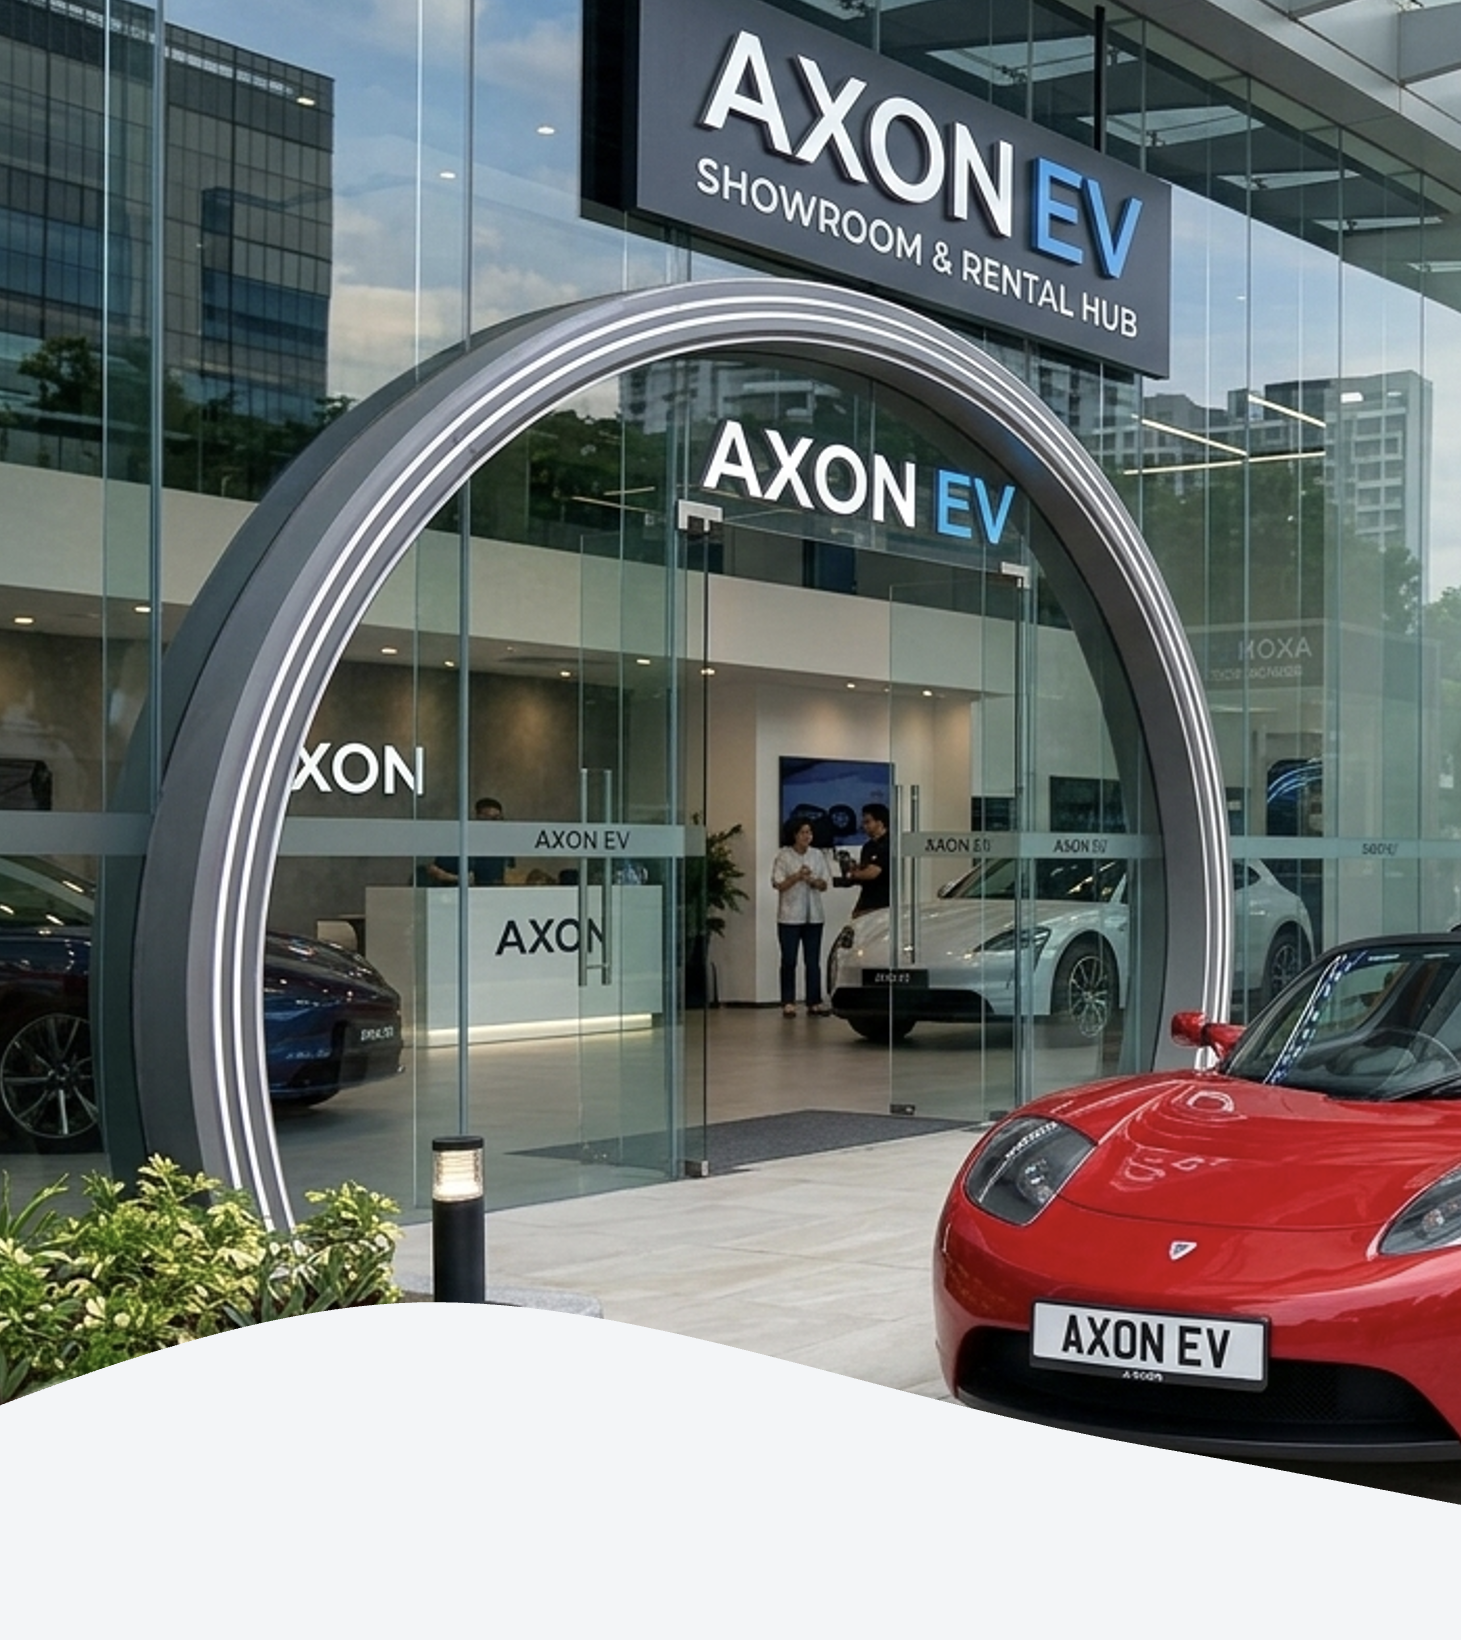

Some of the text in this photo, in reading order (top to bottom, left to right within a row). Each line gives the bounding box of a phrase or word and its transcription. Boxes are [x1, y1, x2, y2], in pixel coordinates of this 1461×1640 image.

[702, 30, 1143, 280] AXON EV
[696, 158, 1138, 338] SHOWROOM & RENTAL HUB
[703, 420, 1015, 545] AXON EV
[290, 742, 423, 795] XON
[534, 830, 631, 850] AXON EV
[495, 918, 607, 956] AXON
[1061, 1314, 1231, 1369] AXON EV
